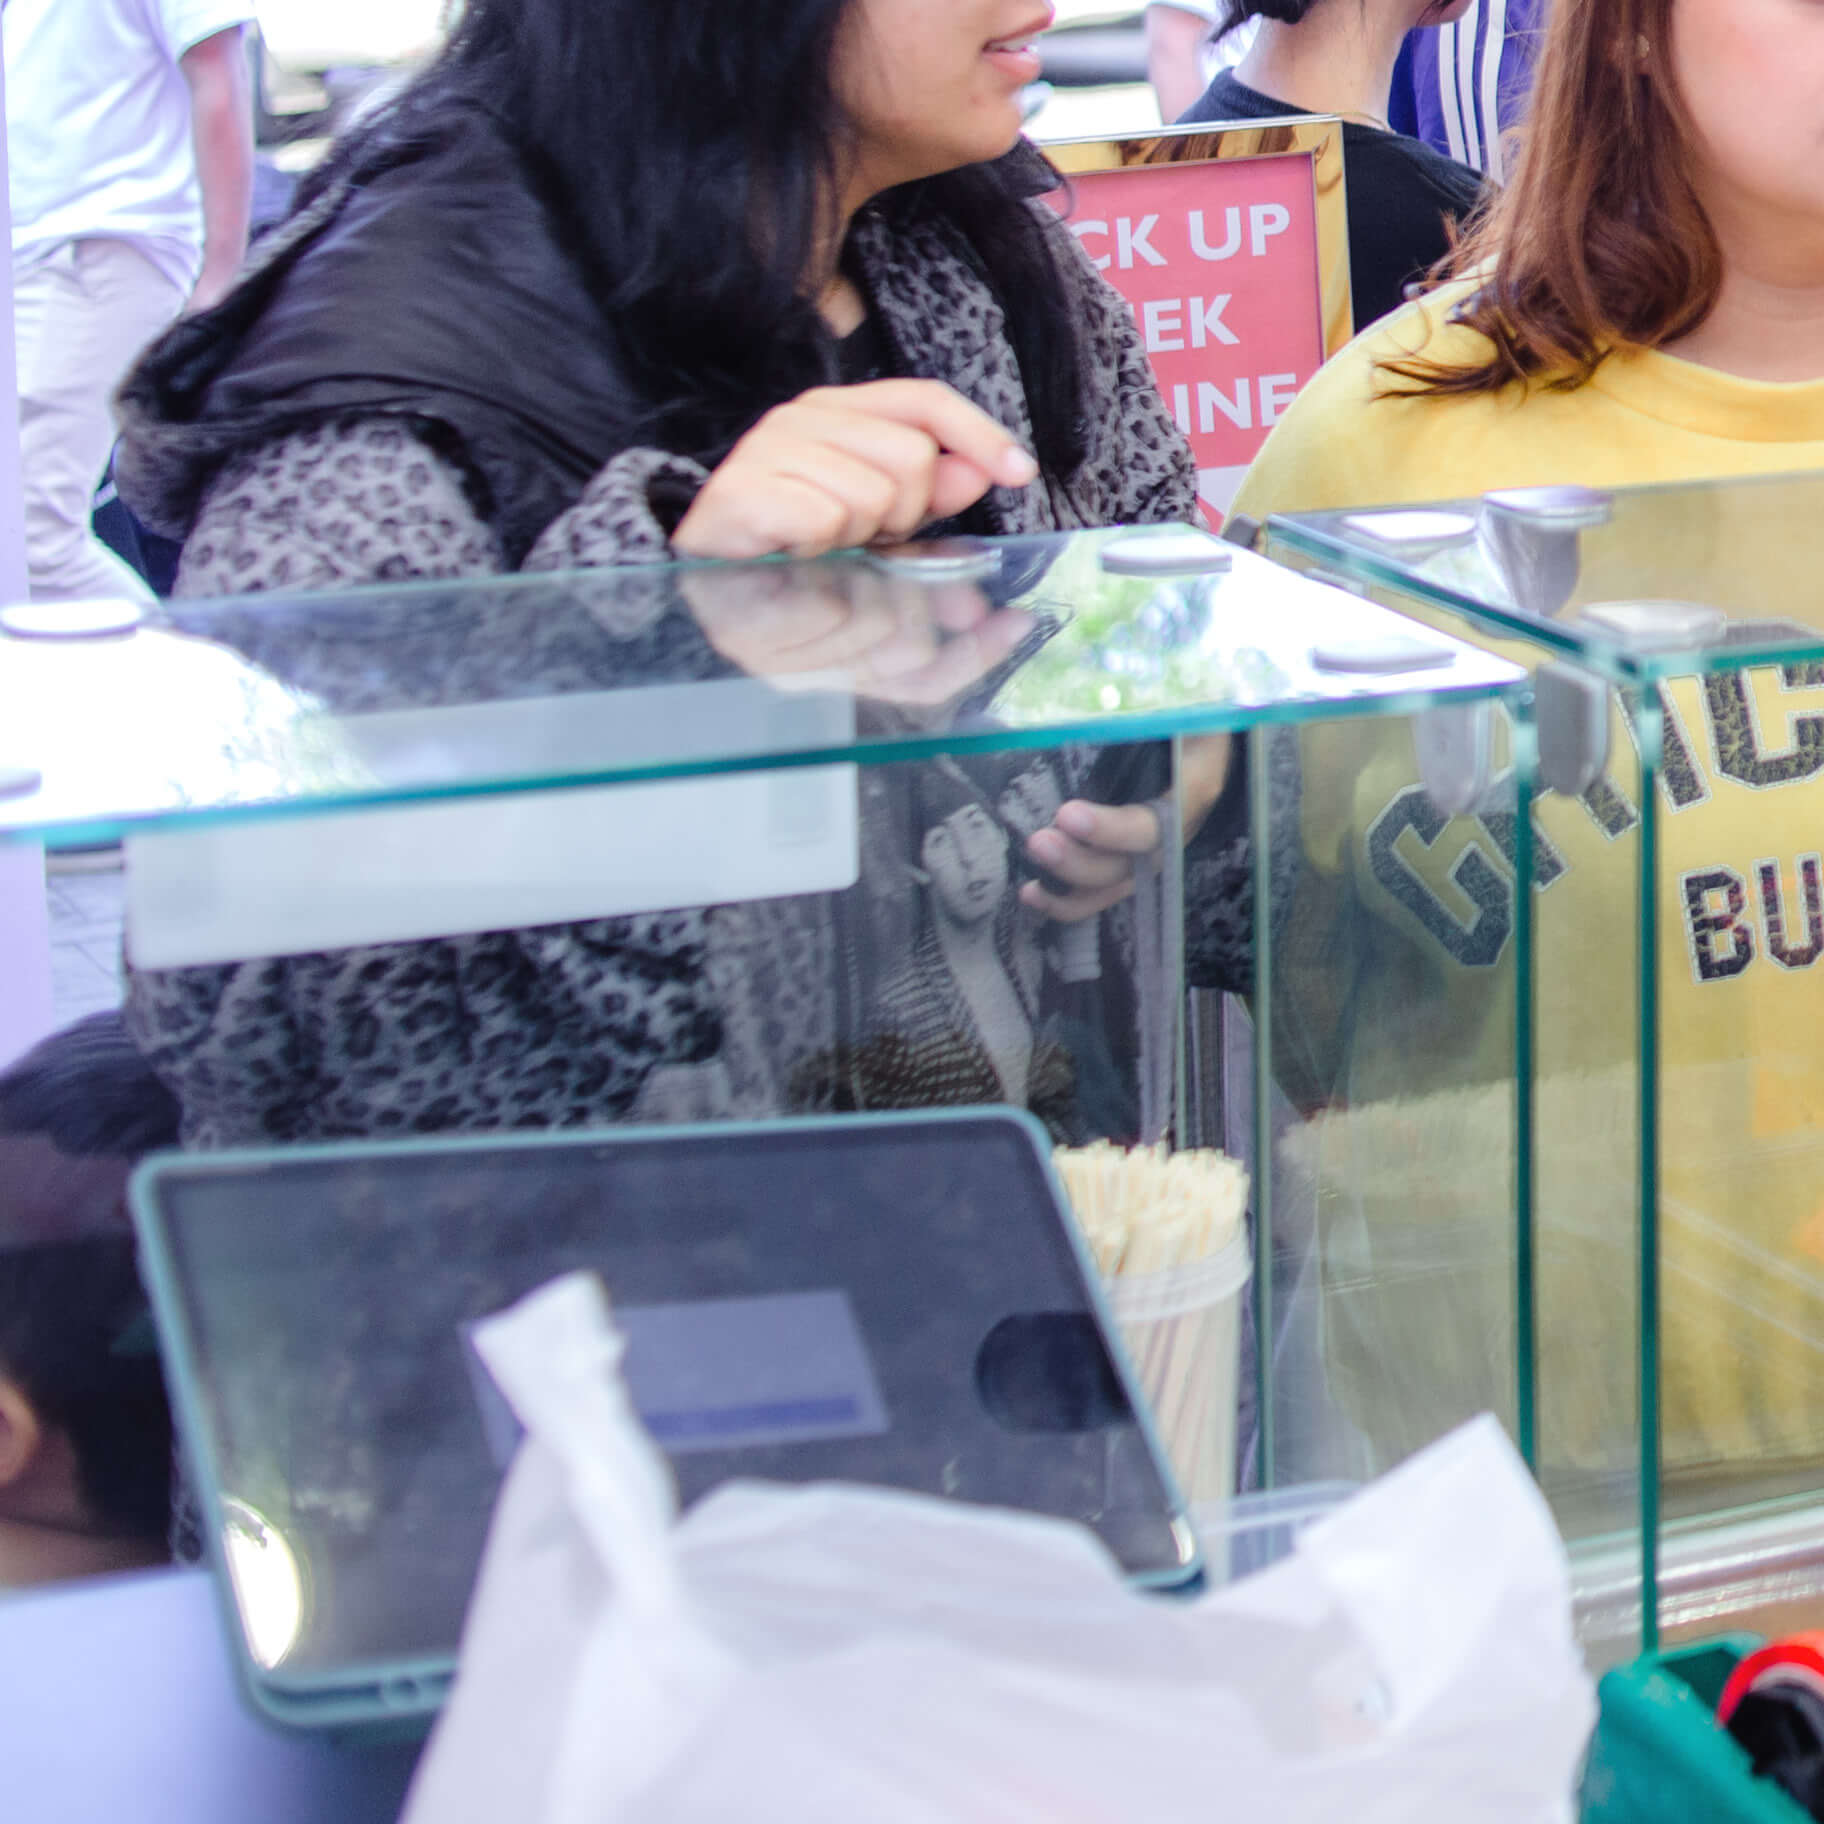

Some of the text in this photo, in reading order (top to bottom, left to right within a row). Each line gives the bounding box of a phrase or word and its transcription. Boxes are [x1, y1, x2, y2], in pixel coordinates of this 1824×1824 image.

[1070, 203, 1290, 271] CK UP
[1129, 293, 1241, 353] EK
[1173, 373, 1297, 436] INE
